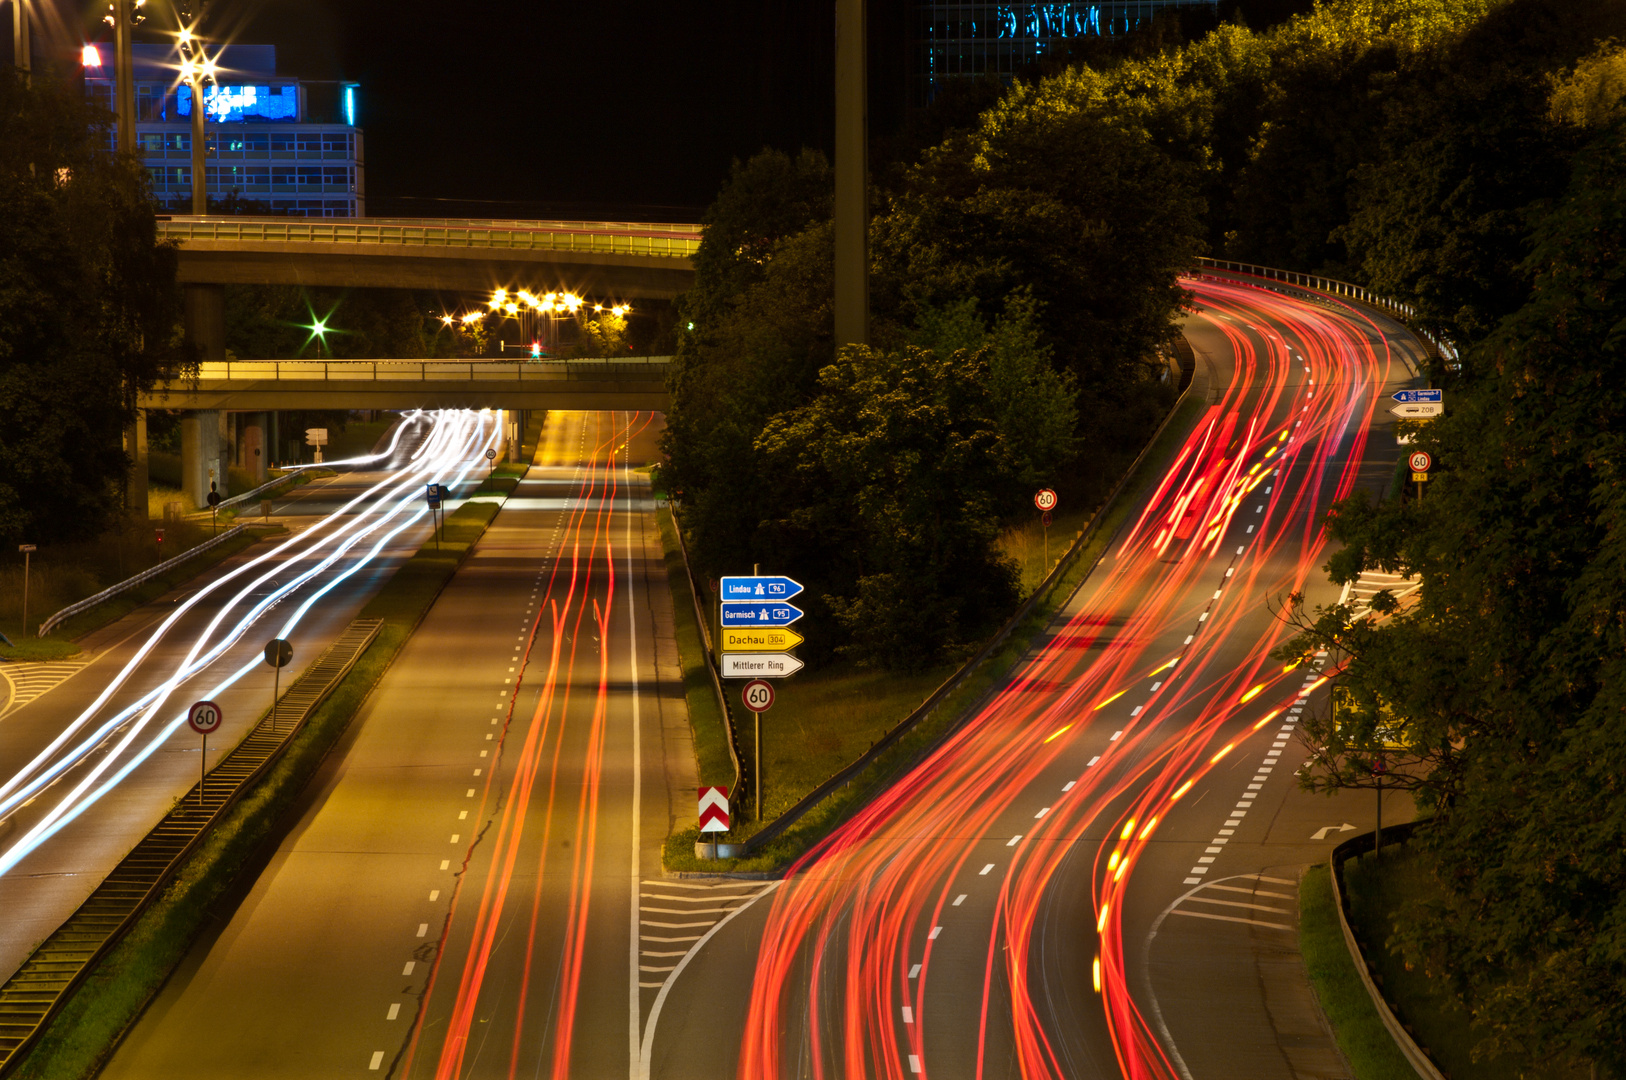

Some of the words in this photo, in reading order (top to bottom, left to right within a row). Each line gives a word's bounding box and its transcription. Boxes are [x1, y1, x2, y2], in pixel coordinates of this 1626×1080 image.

[1414, 457, 1426, 467] 60
[1040, 494, 1052, 504] 60
[729, 585, 751, 594] Lindau
[725, 611, 755, 619] Garmisch
[729, 635, 765, 644] Dachau
[732, 661, 764, 670] Mittlerer
[768, 661, 784, 671] Ring
[750, 689, 768, 703] 60
[196, 710, 215, 725] 60
